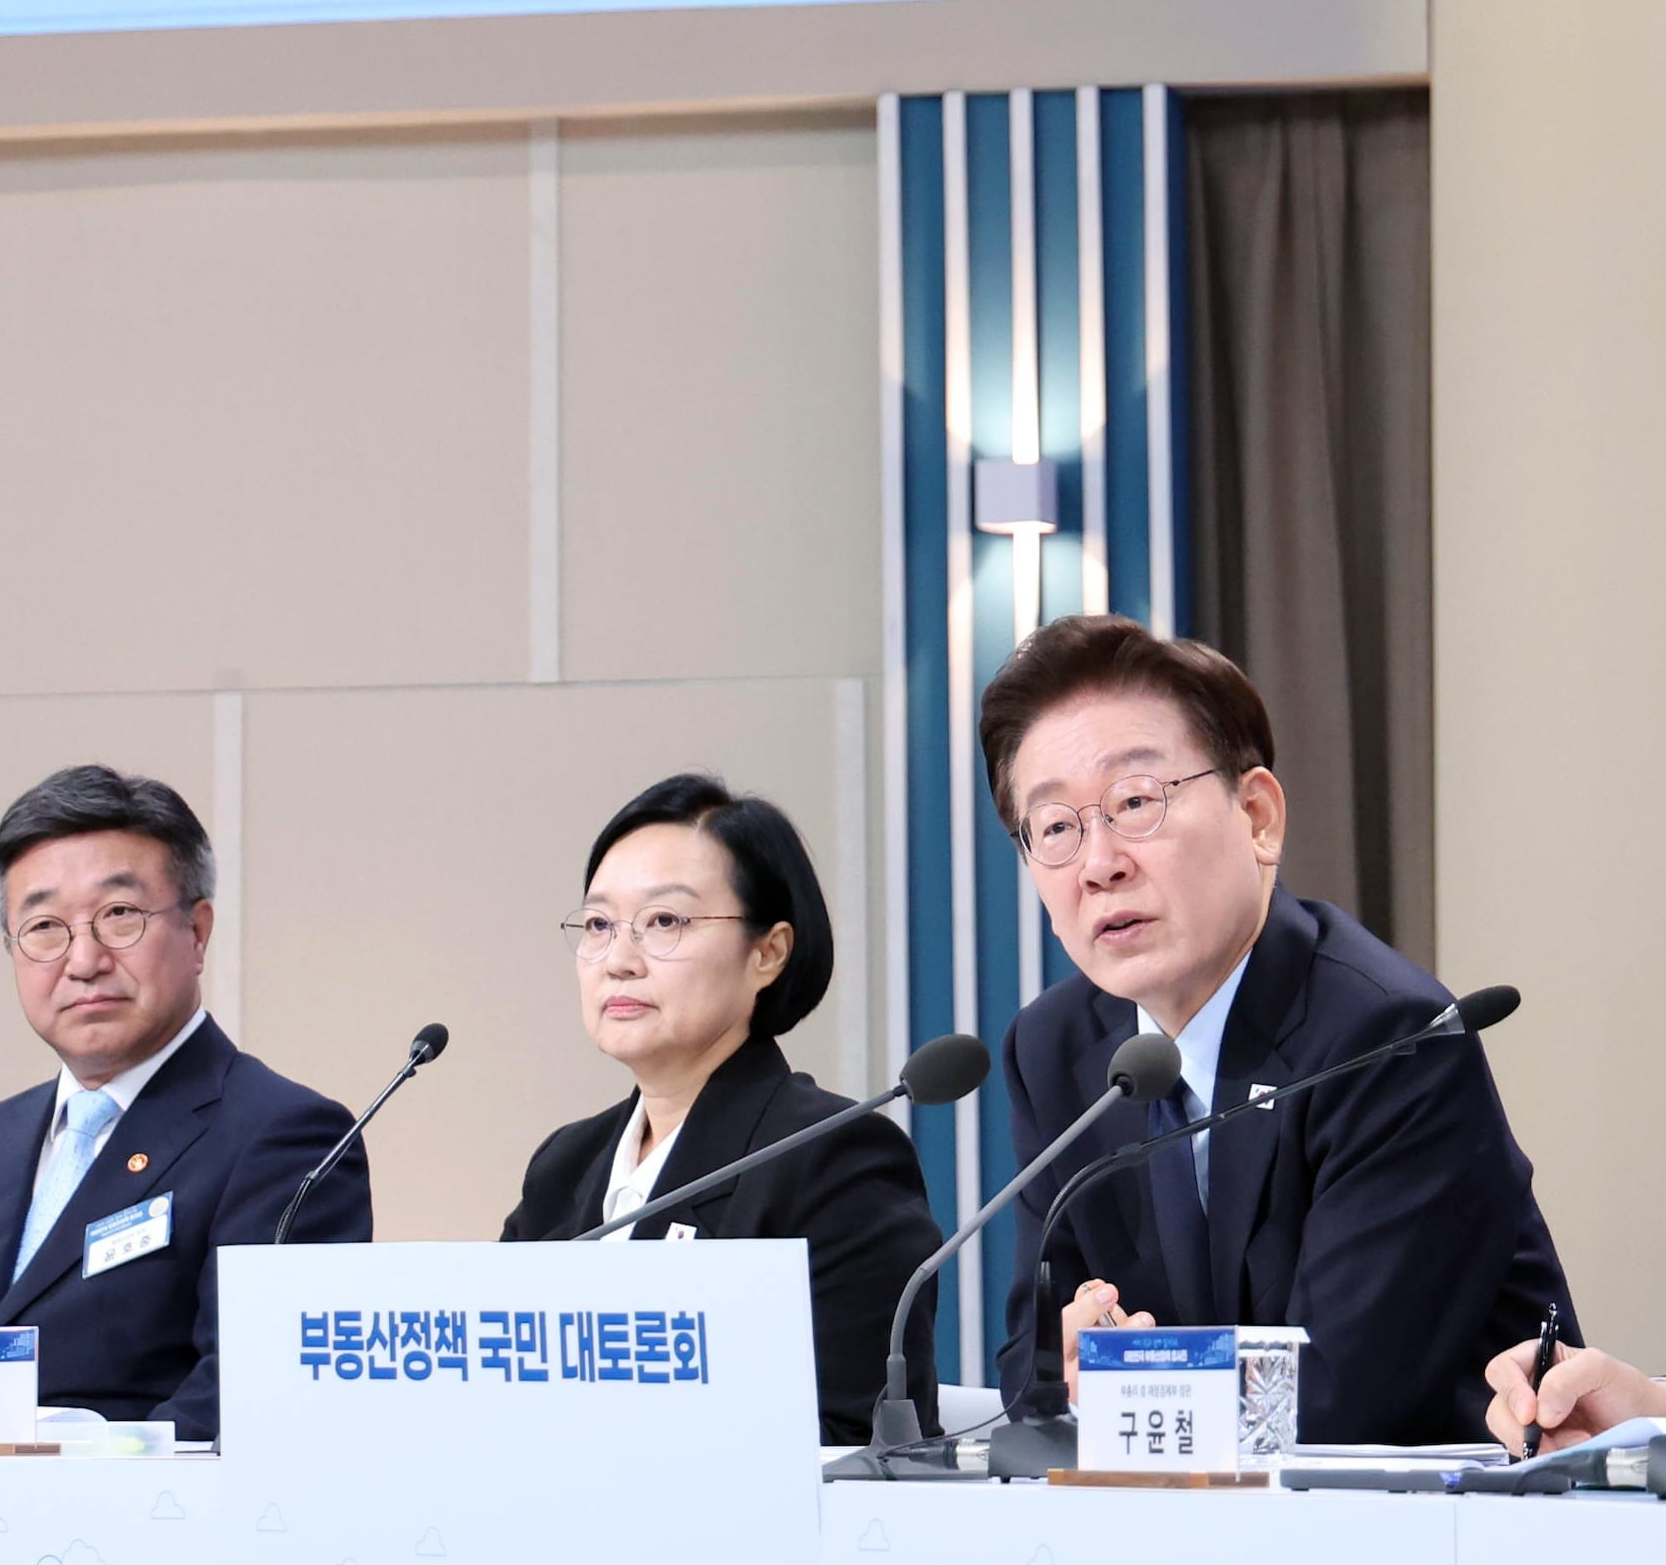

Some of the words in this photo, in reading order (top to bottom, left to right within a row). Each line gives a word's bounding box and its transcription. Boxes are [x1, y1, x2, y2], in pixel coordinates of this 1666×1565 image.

[299, 1309, 469, 1383] 부동산정책
[477, 1309, 549, 1383] 국민
[558, 1309, 710, 1385] 대토론회
[1118, 1409, 1194, 1455] 구윤철
